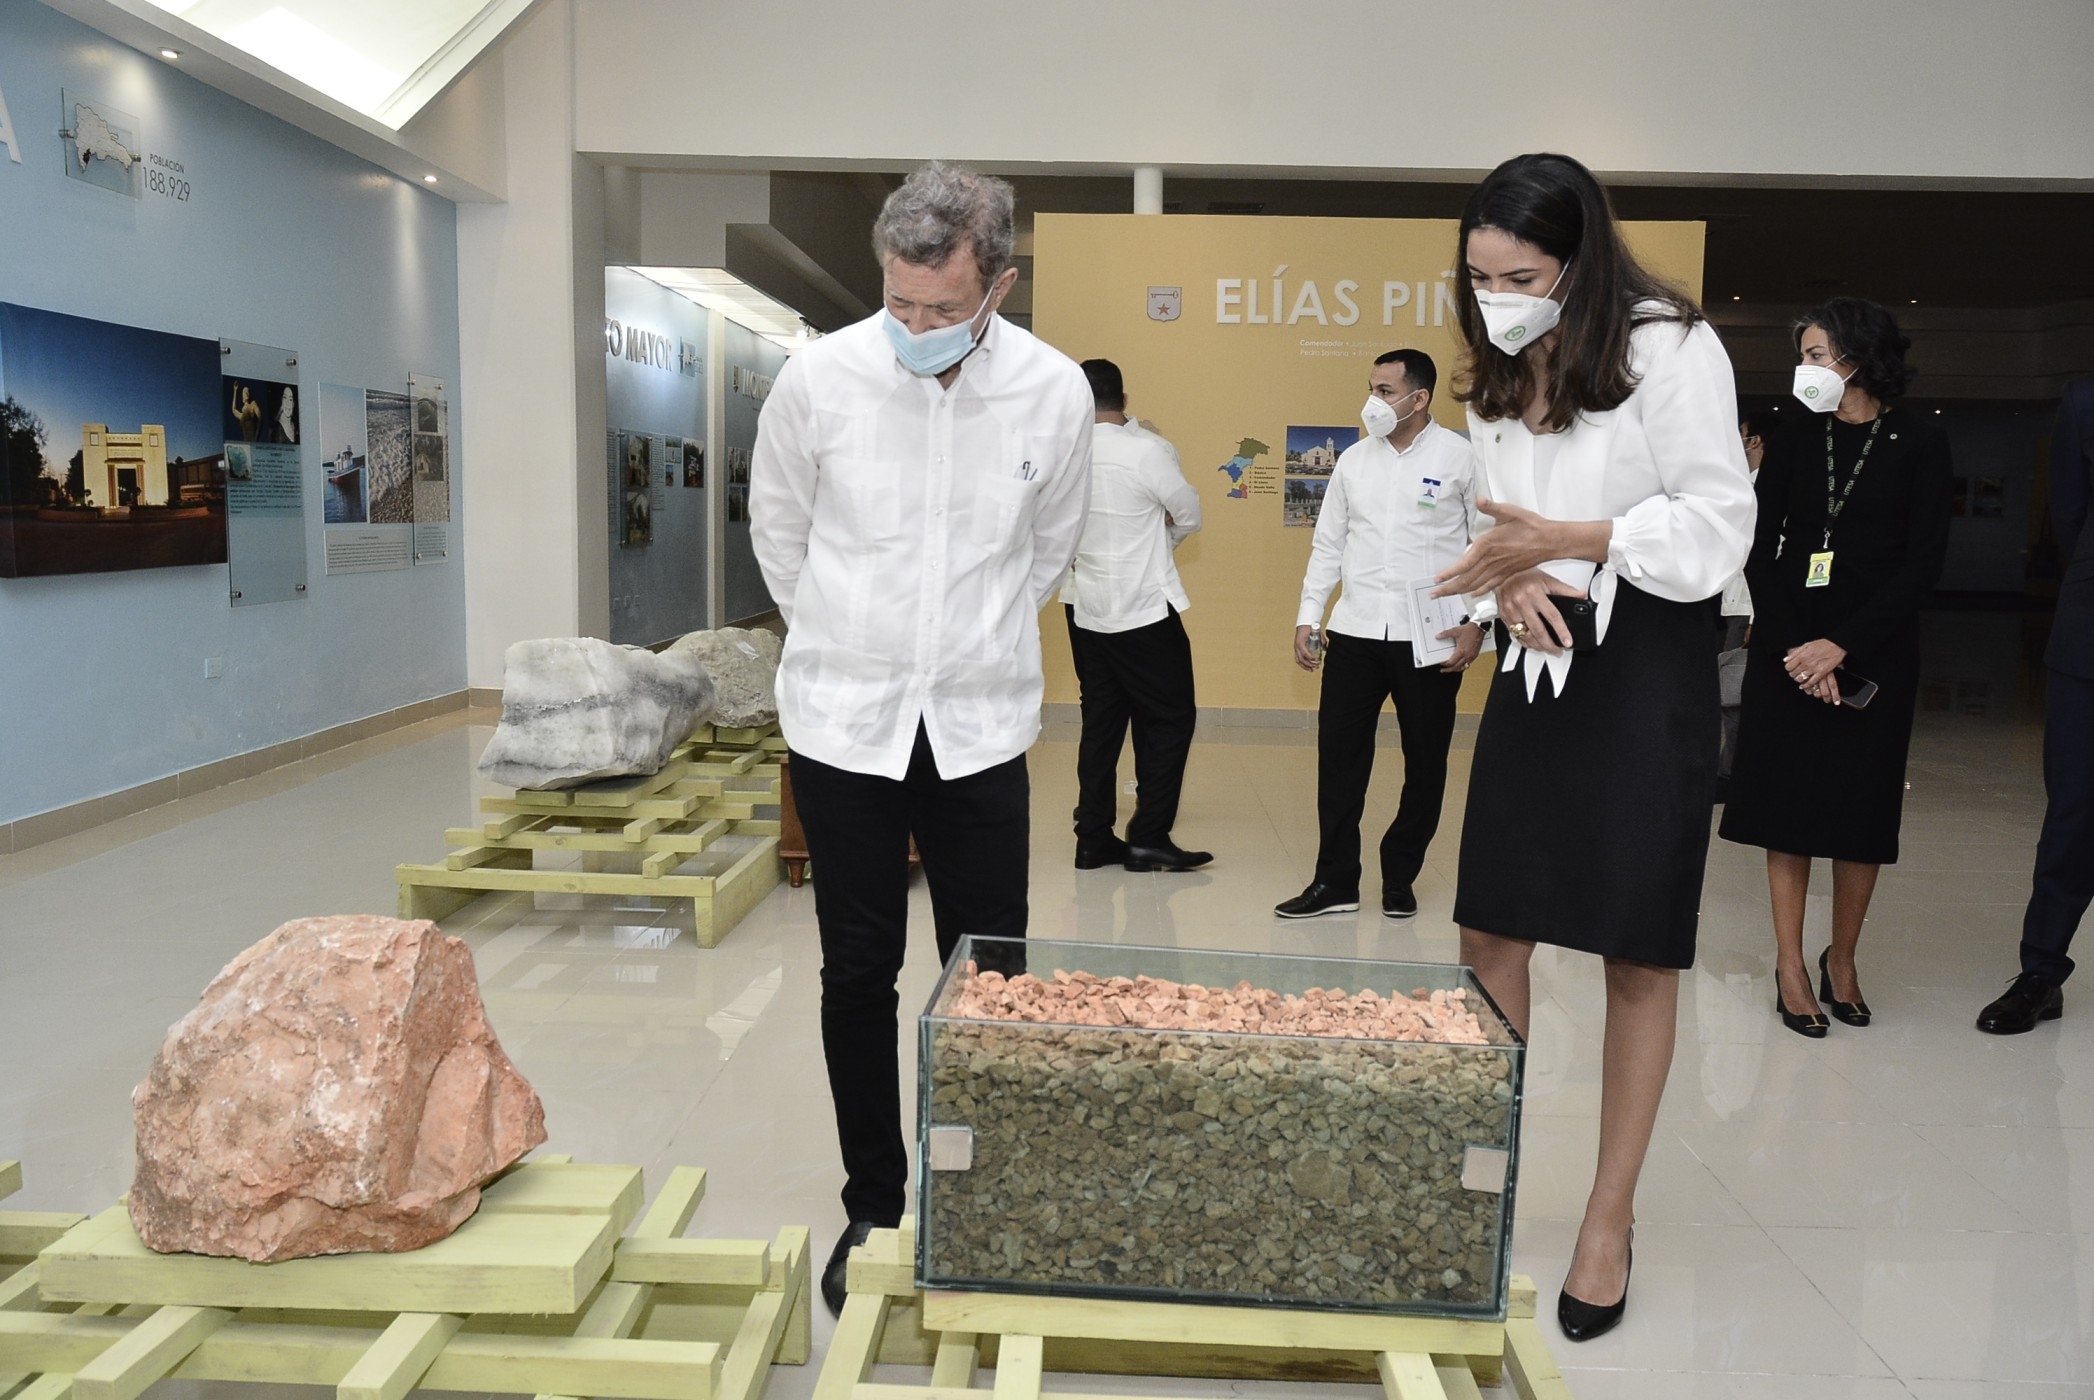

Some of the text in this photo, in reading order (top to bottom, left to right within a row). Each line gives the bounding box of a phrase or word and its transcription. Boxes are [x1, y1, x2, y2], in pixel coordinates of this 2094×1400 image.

[143, 166, 191, 202] 188,929
[1216, 264, 1458, 327] ELÍAS PIÑ
[625, 326, 673, 372] MAYOR
